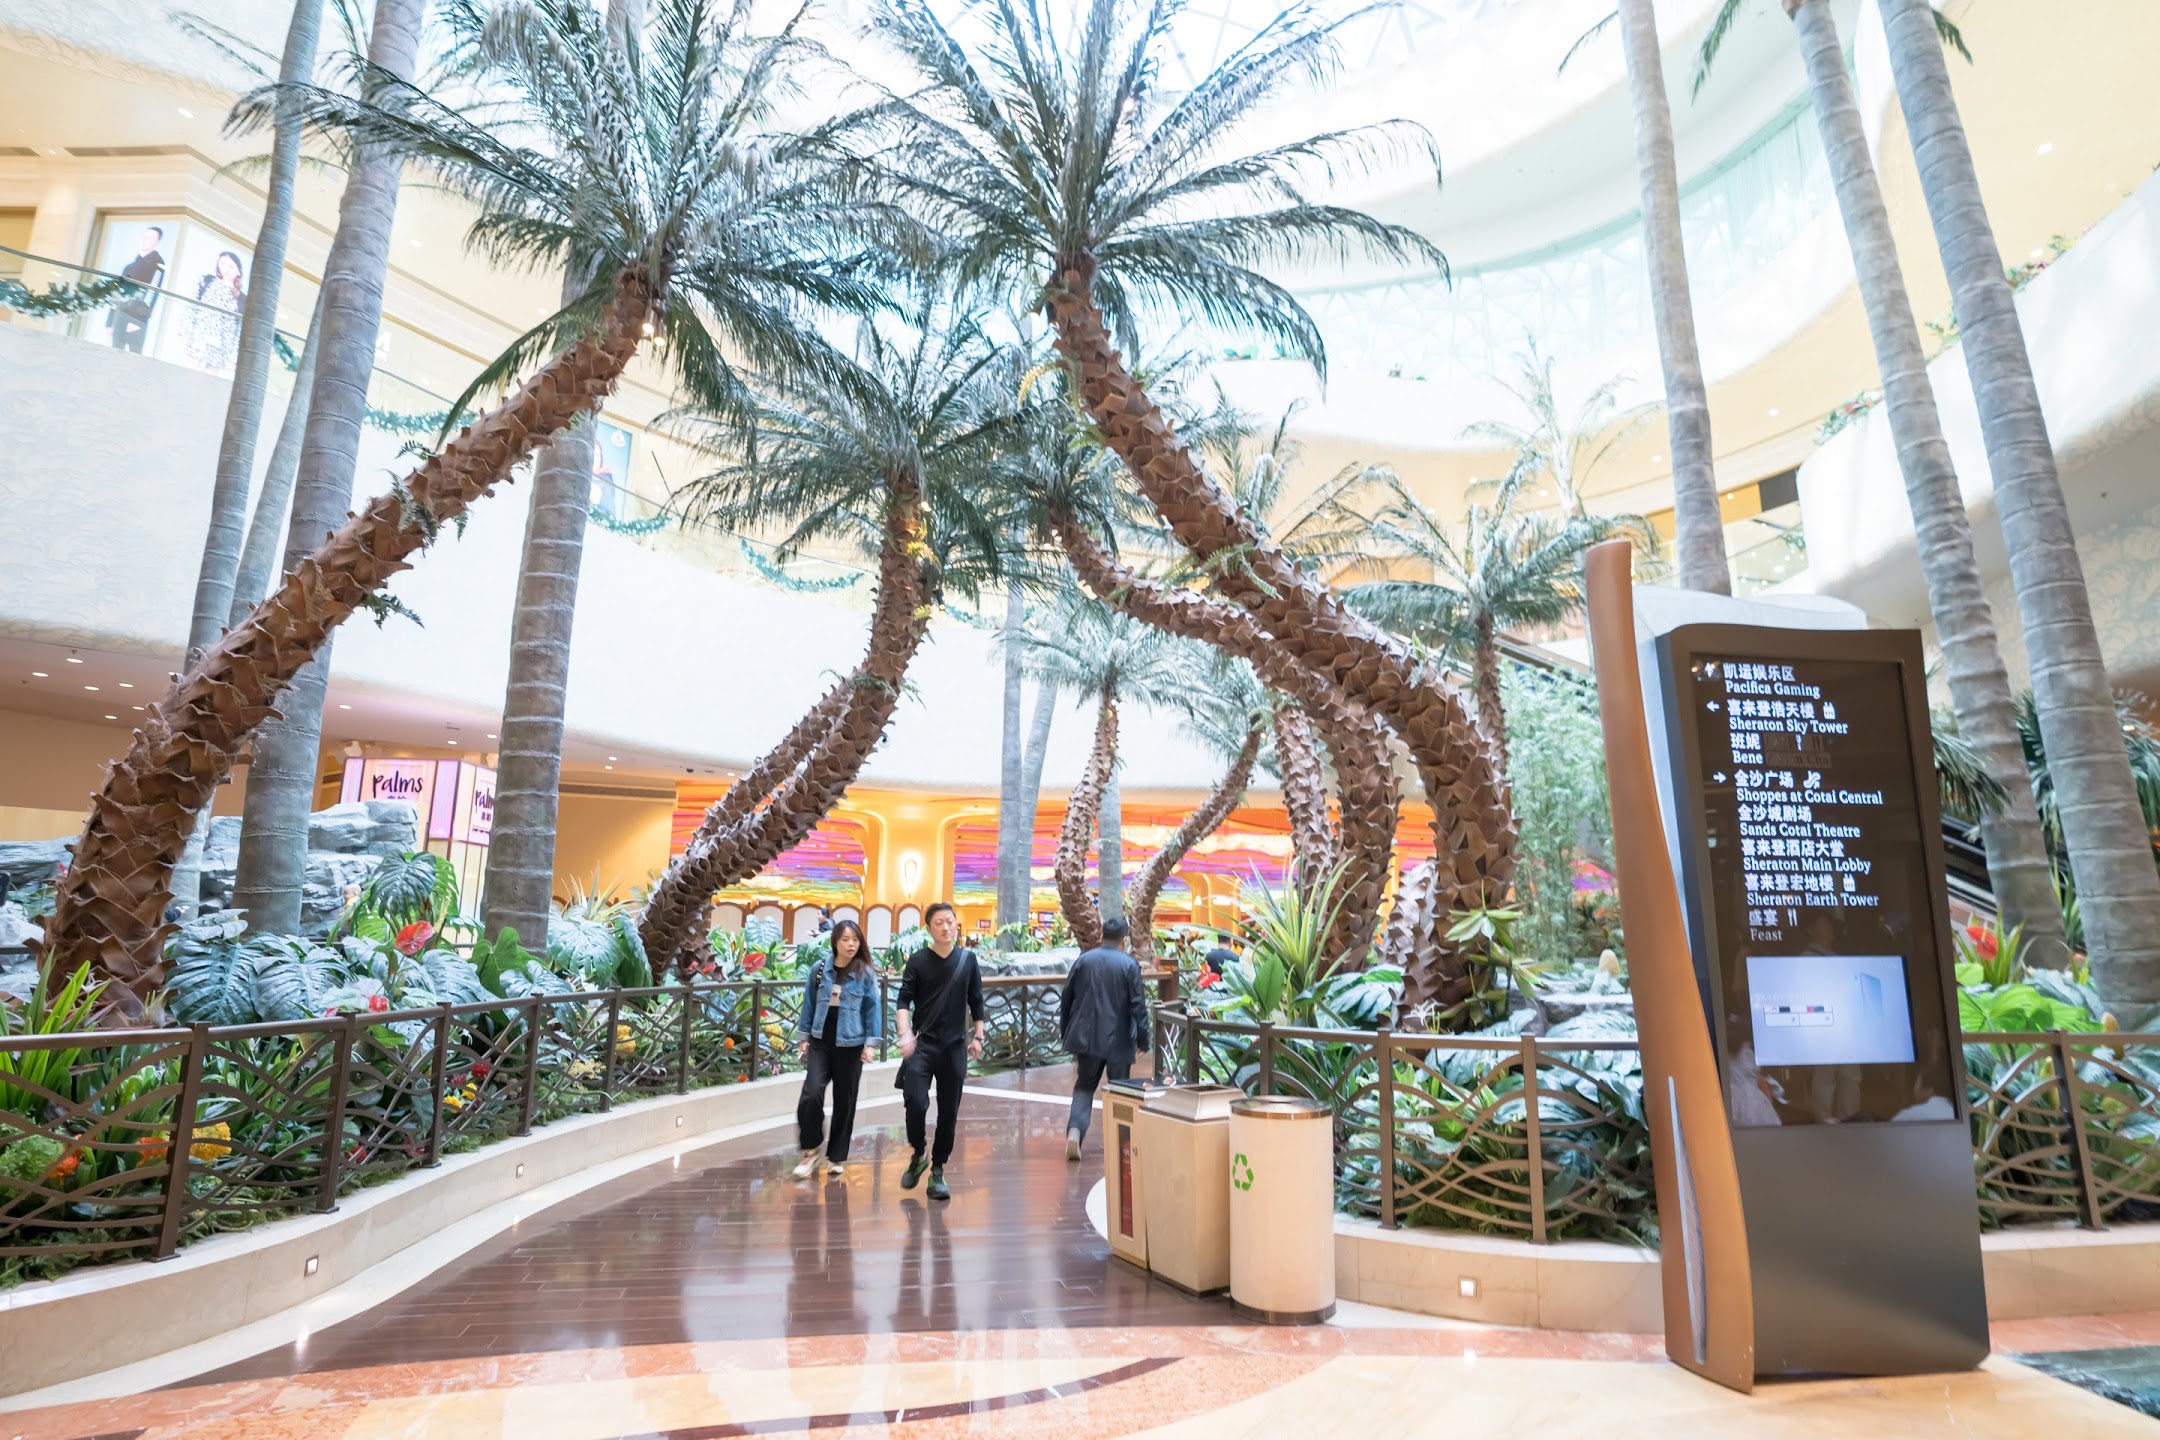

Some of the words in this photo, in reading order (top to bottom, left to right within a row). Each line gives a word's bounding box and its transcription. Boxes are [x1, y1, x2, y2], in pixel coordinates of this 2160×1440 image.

[1723, 663, 1795, 681] 凯运娱乐区
[1725, 679, 1771, 694] Pacifica
[1774, 682, 1820, 699] Gaming
[1730, 717, 1784, 731] Sheraton
[1787, 719, 1807, 735] Sky
[1810, 720, 1848, 733] Tower
[1733, 750, 1763, 764] Bene
[373, 770, 424, 799] palms
[1735, 769, 1793, 789] 金沙广场
[1737, 788, 1787, 804] Shoppes
[1791, 791, 1802, 802] at
[1805, 790, 1836, 803] Cotai
[1839, 791, 1883, 804] Central
[1738, 804, 1811, 822] 金沙城剧场
[1740, 822, 1776, 836] Sands
[1779, 823, 1811, 836] Cotai
[1813, 824, 1860, 837] Theatre
[1741, 839, 1844, 857] 喜来登酒店大堂
[1744, 857, 1799, 870] Sheraton
[1801, 858, 1832, 871] Main
[1835, 858, 1871, 875] Lobby
[1745, 873, 1833, 891] 喜来登宏地楼
[1747, 892, 1802, 905] Sheraton
[1805, 892, 1838, 905] Earth
[1841, 893, 1878, 906] Tower
[1749, 909, 1778, 926] 盛宴
[1751, 928, 1782, 940] Feast
